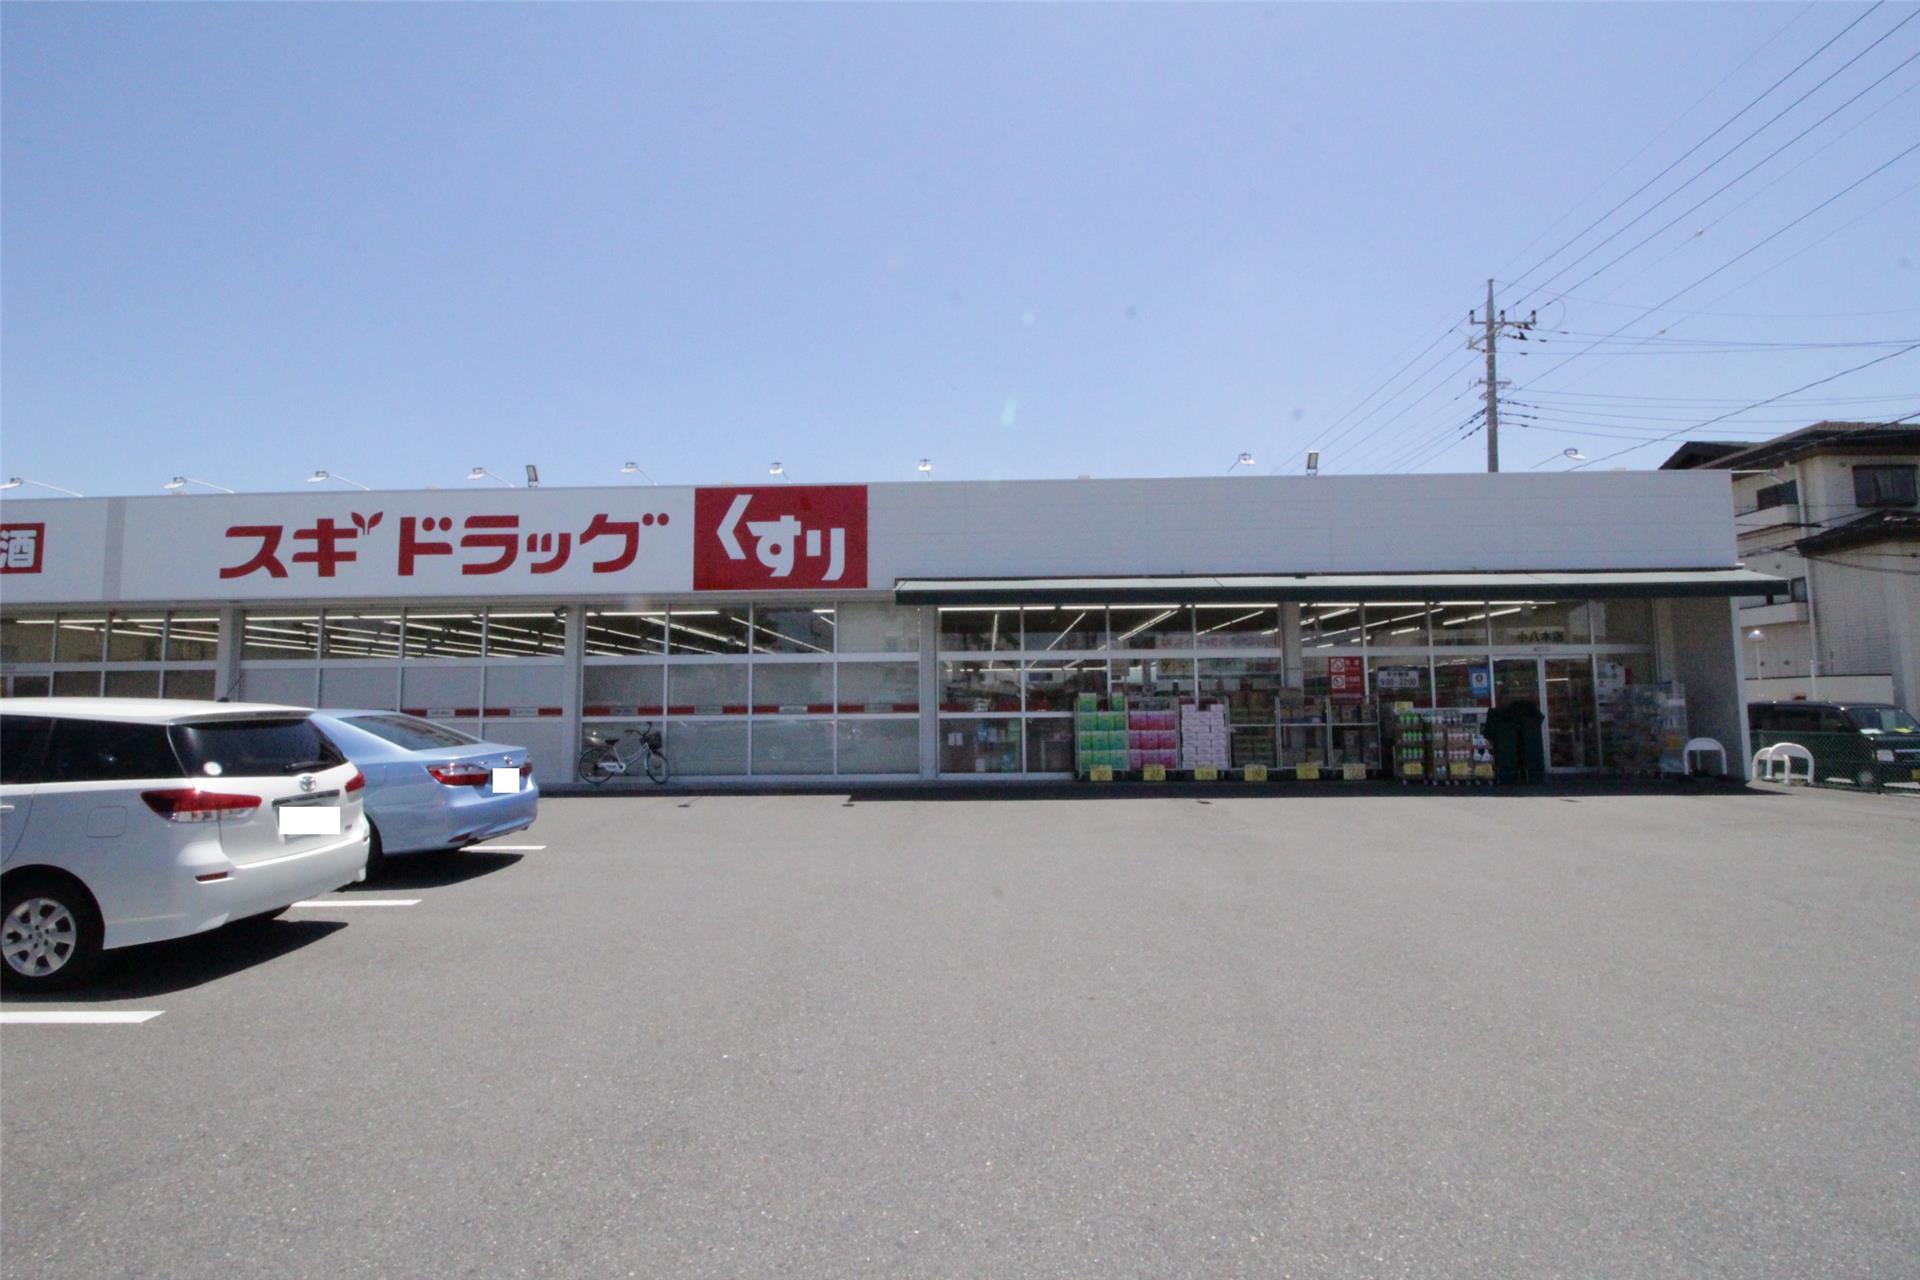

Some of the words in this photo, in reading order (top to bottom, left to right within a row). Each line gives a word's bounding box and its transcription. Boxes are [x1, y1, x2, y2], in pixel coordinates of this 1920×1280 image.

[0, 530, 37, 568] 酒
[716, 494, 845, 581] くすり
